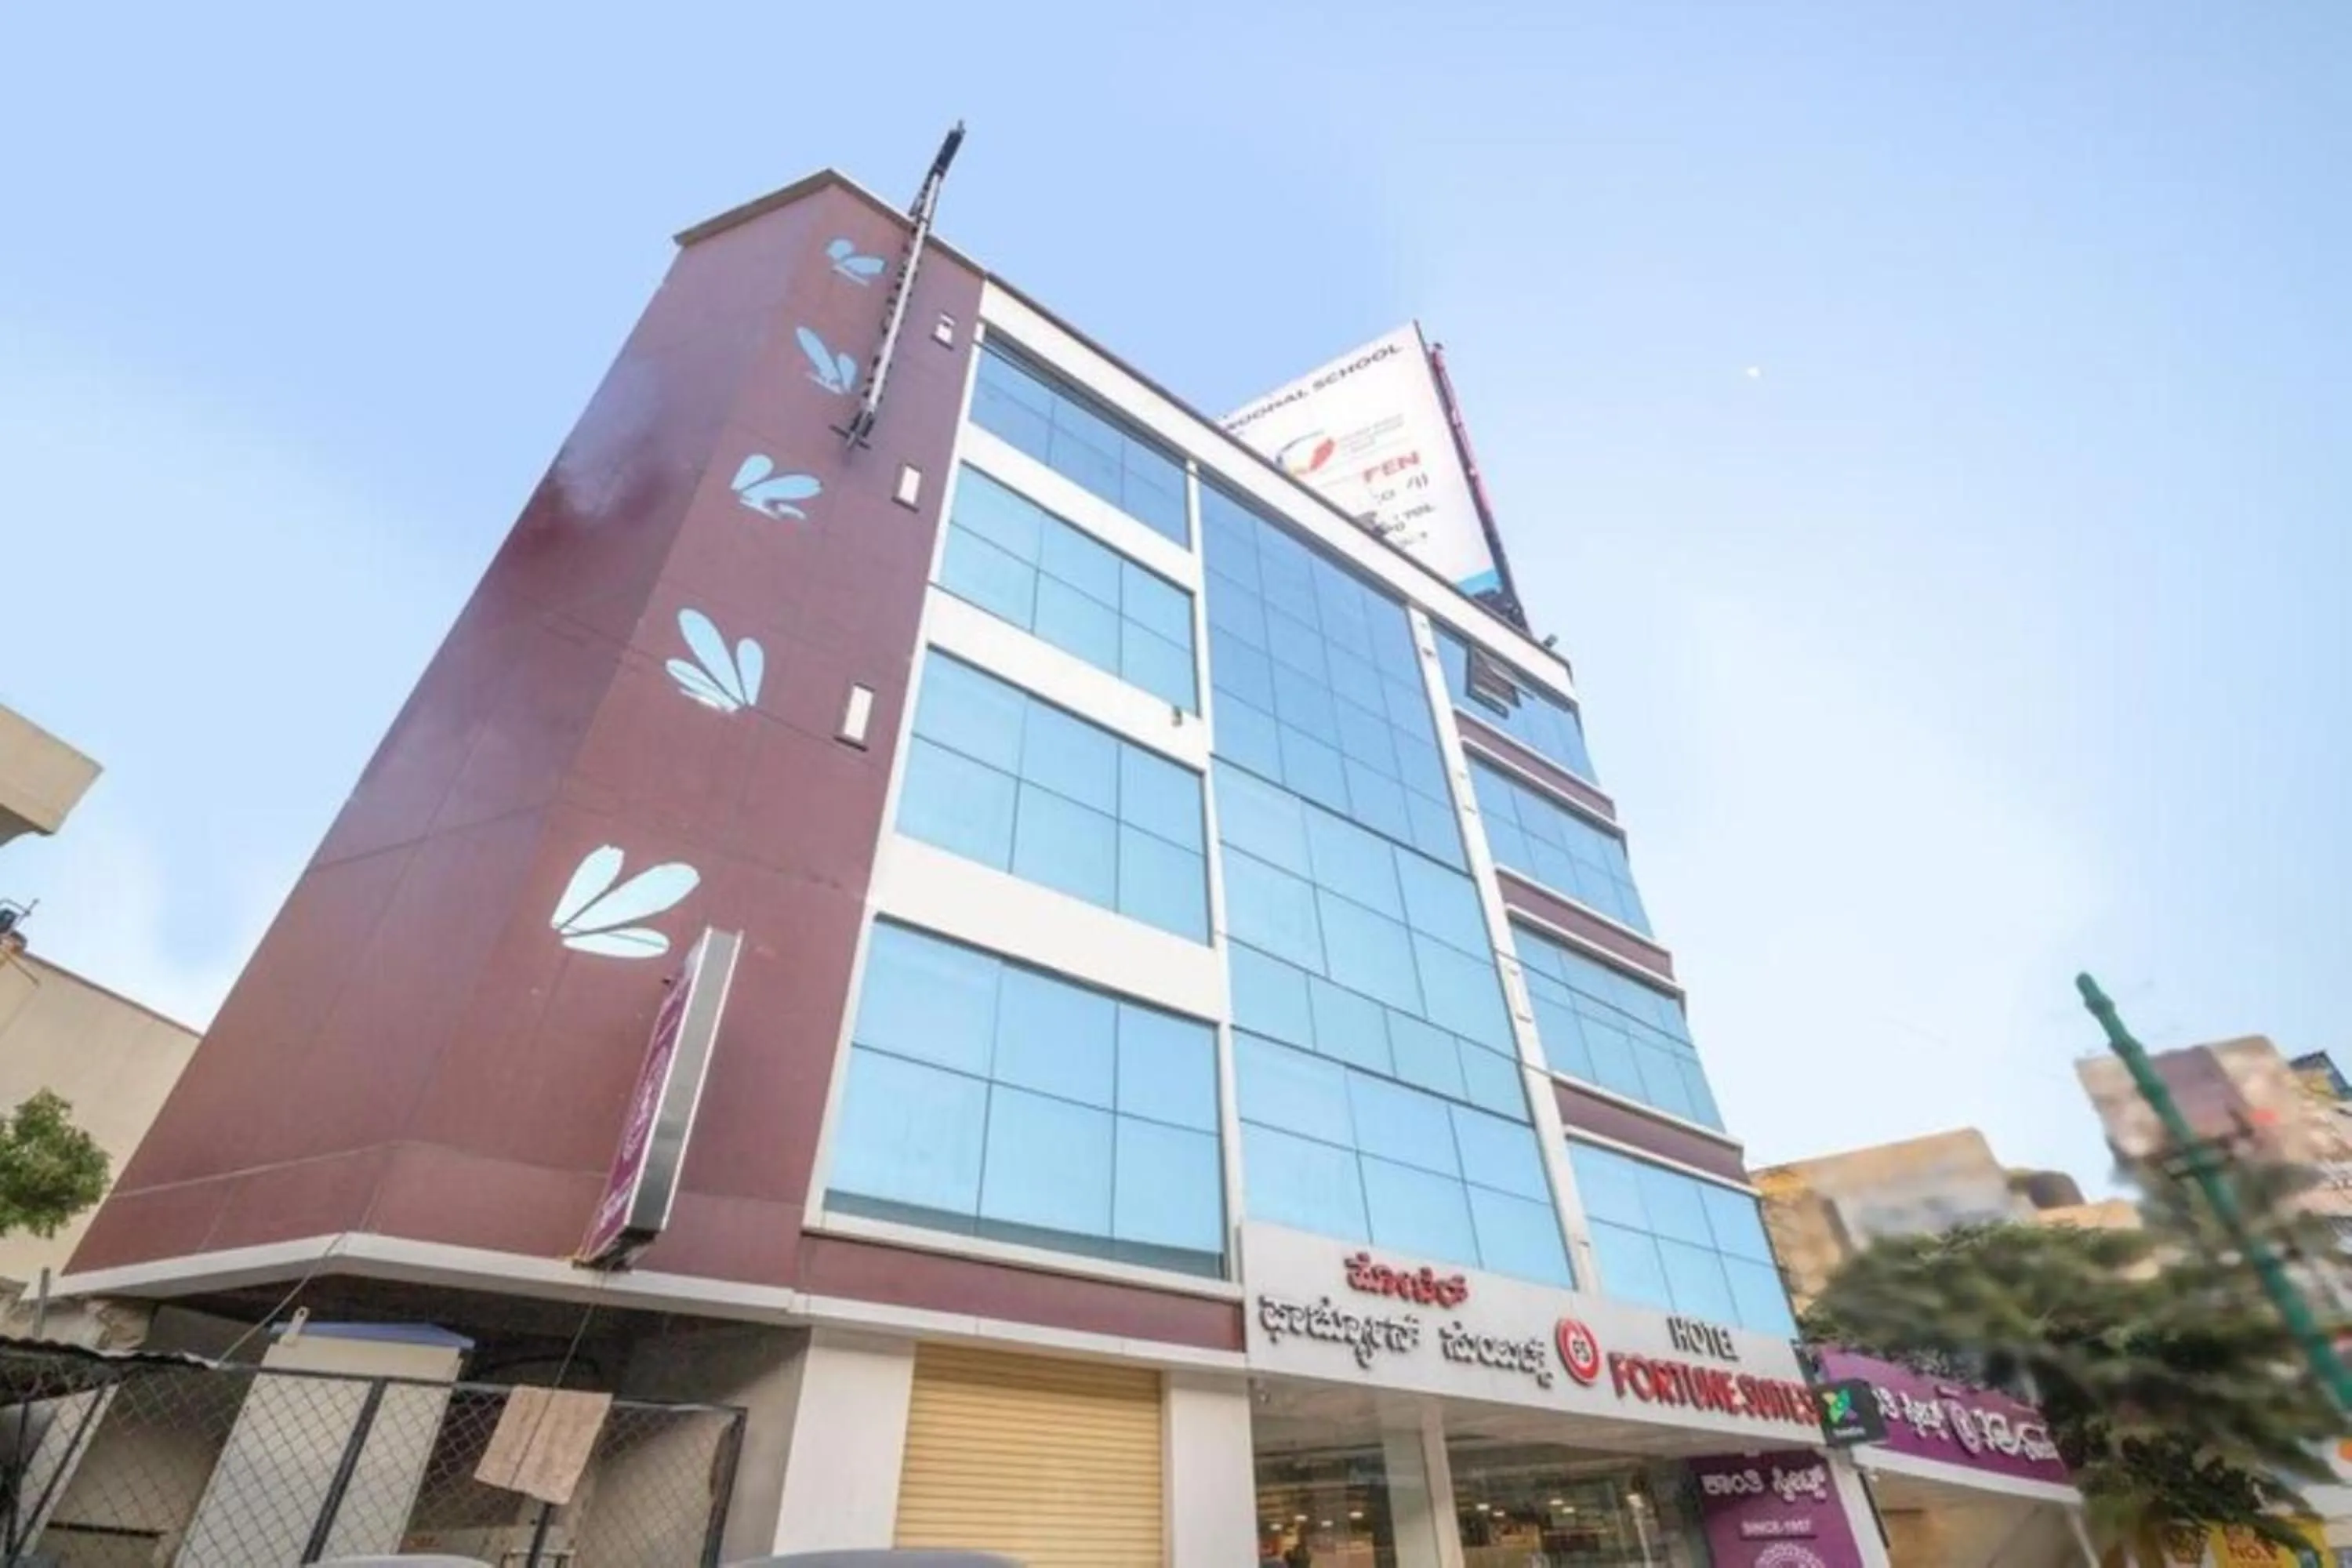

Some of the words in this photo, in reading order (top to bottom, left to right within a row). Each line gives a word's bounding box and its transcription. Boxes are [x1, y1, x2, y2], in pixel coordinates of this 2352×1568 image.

[1312, 344, 1403, 392] SCHOOL
[1667, 1316, 1740, 1362] HOTEL
[1607, 1352, 1743, 1416] FORTUNE
[1736, 1374, 1822, 1427] SUITES
